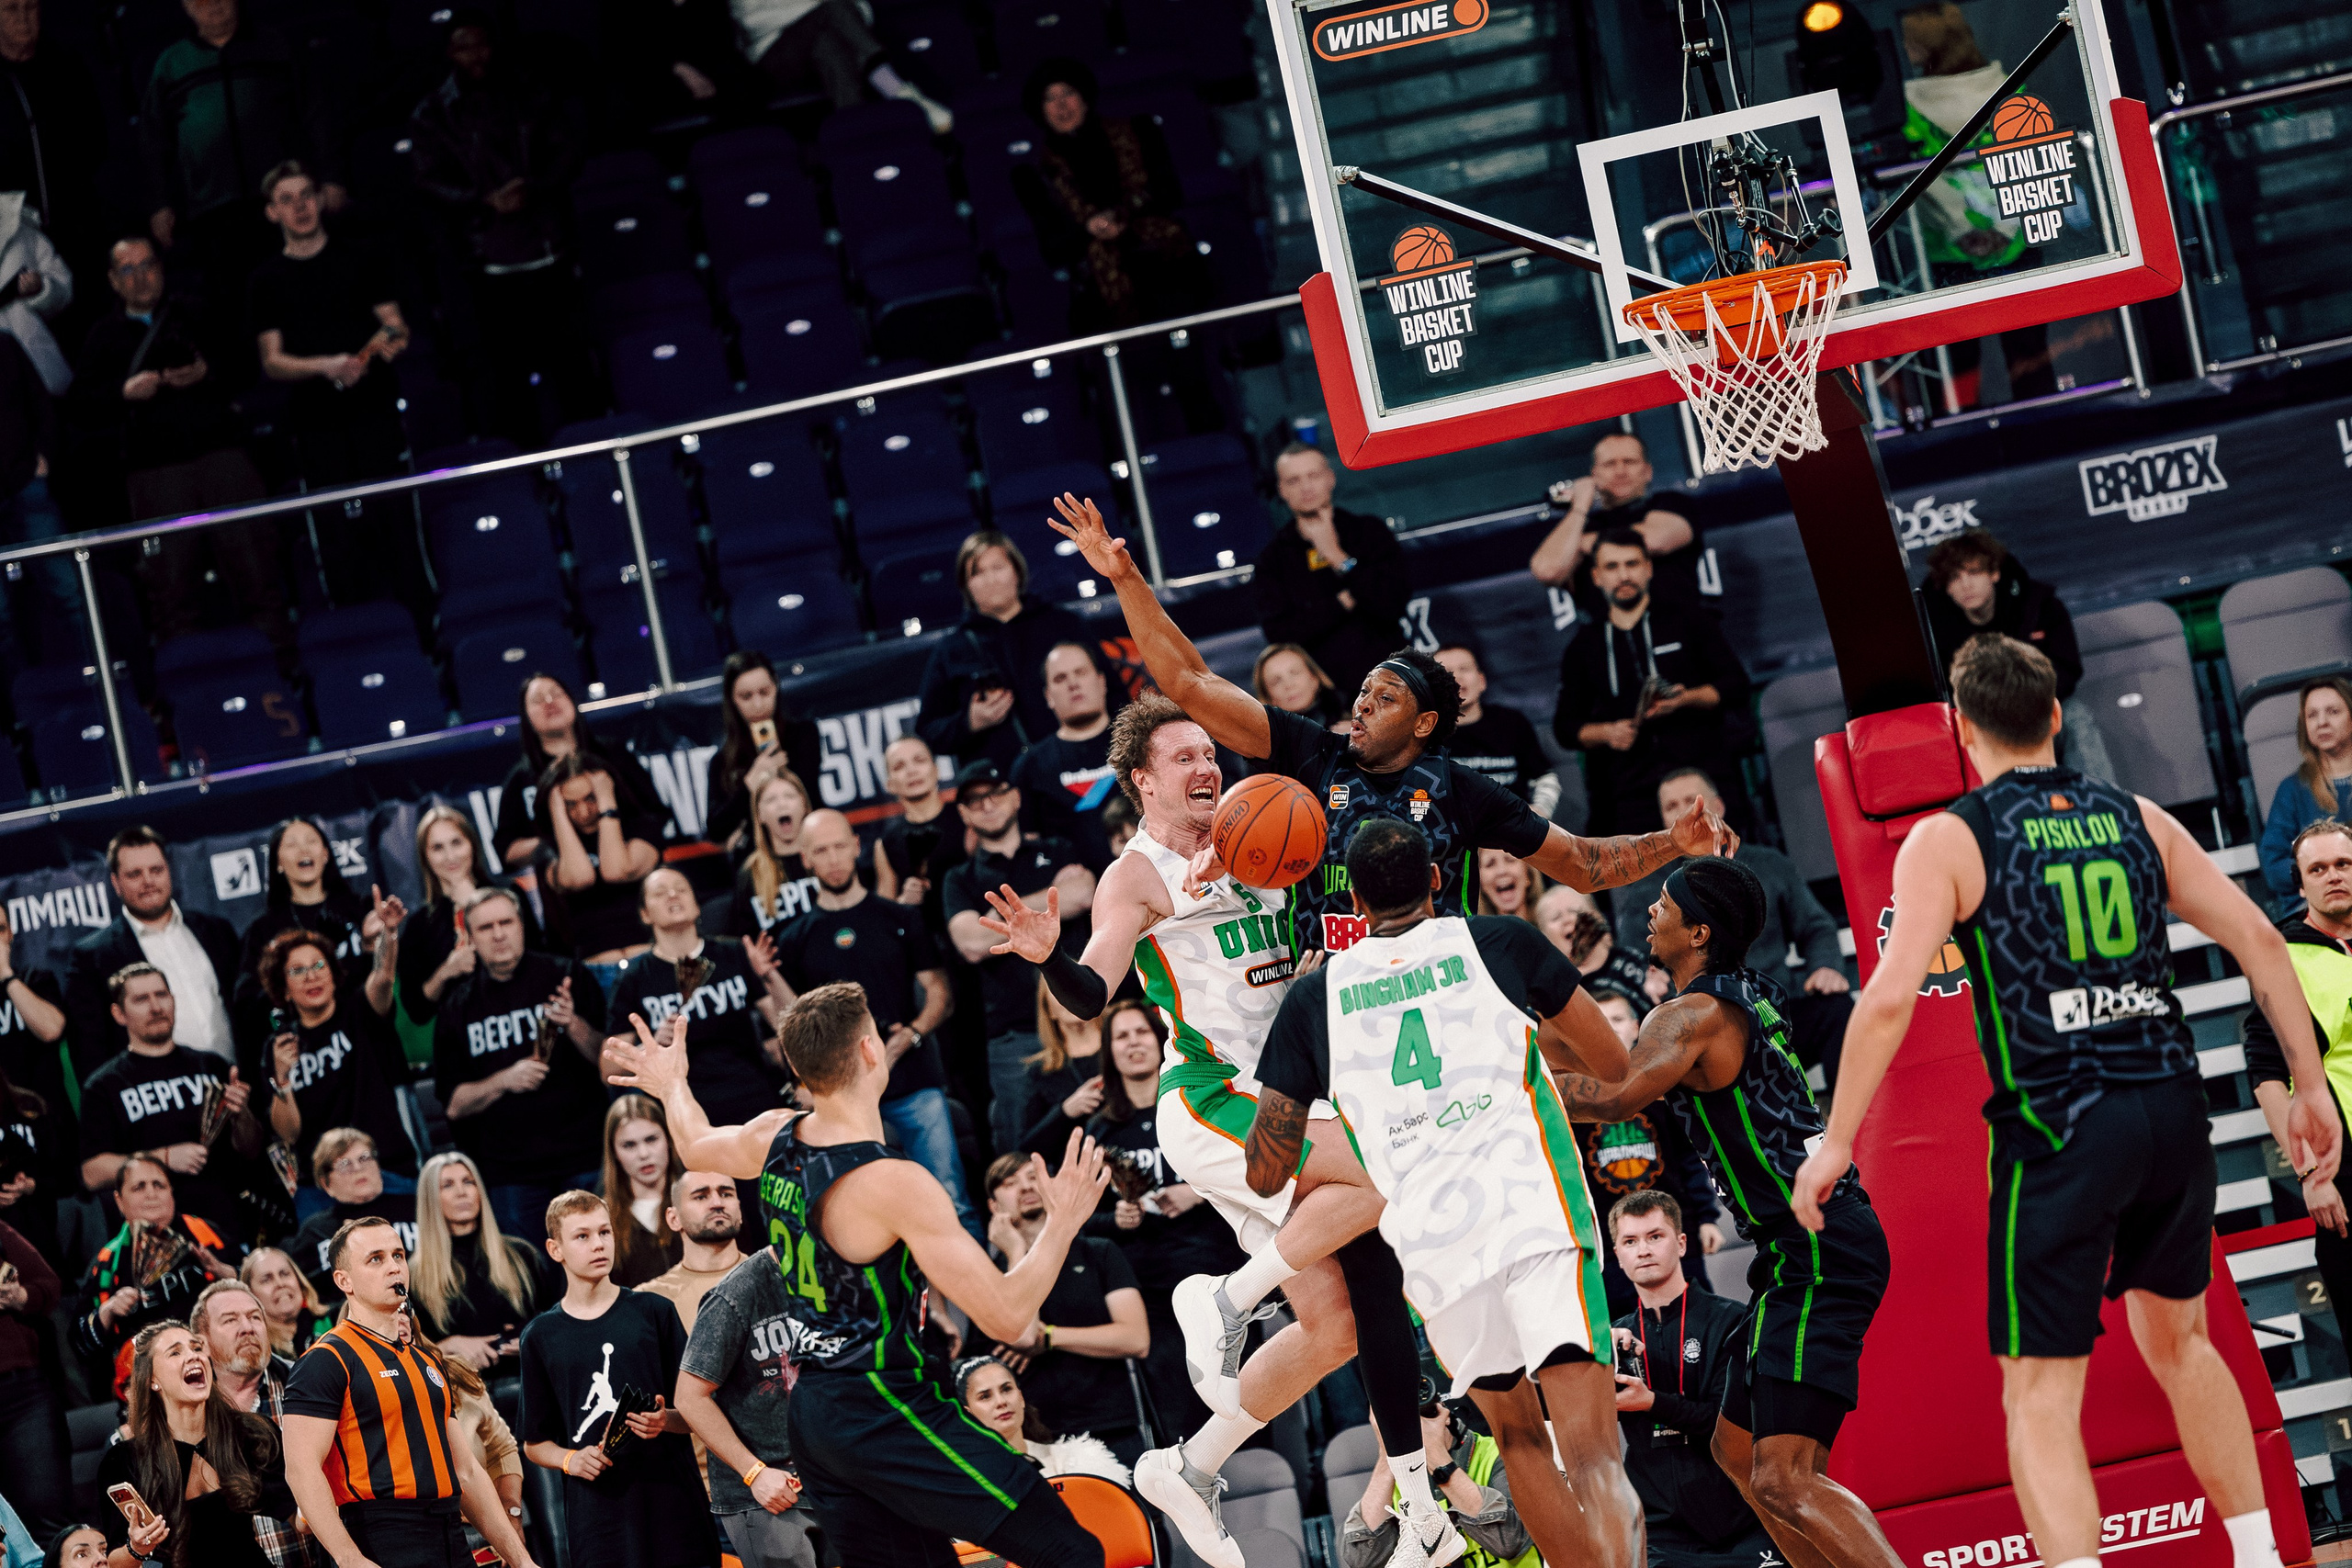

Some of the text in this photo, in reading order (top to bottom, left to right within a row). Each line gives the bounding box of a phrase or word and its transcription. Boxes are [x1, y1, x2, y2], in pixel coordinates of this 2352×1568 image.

[1327, 5, 1448, 51] WINLINE
[1985, 140, 2076, 185] WINLINE
[1998, 174, 2073, 216] BASKET
[2024, 209, 2063, 243] CUP
[1385, 270, 1476, 315] WINLINE
[1399, 303, 1474, 345] BASKET
[1424, 339, 1464, 374] CUP
[2084, 441, 2222, 511] BROZEX
[1894, 496, 1981, 540] обек
[2023, 812, 2122, 852] PISKLOV
[1232, 883, 1263, 913] 5
[2044, 858, 2138, 962] 10
[1340, 955, 1468, 1015] BINGHAM JR
[1392, 1008, 1442, 1090] 4
[770, 1218, 828, 1313] 24
[2307, 1281, 2326, 1304] 2
